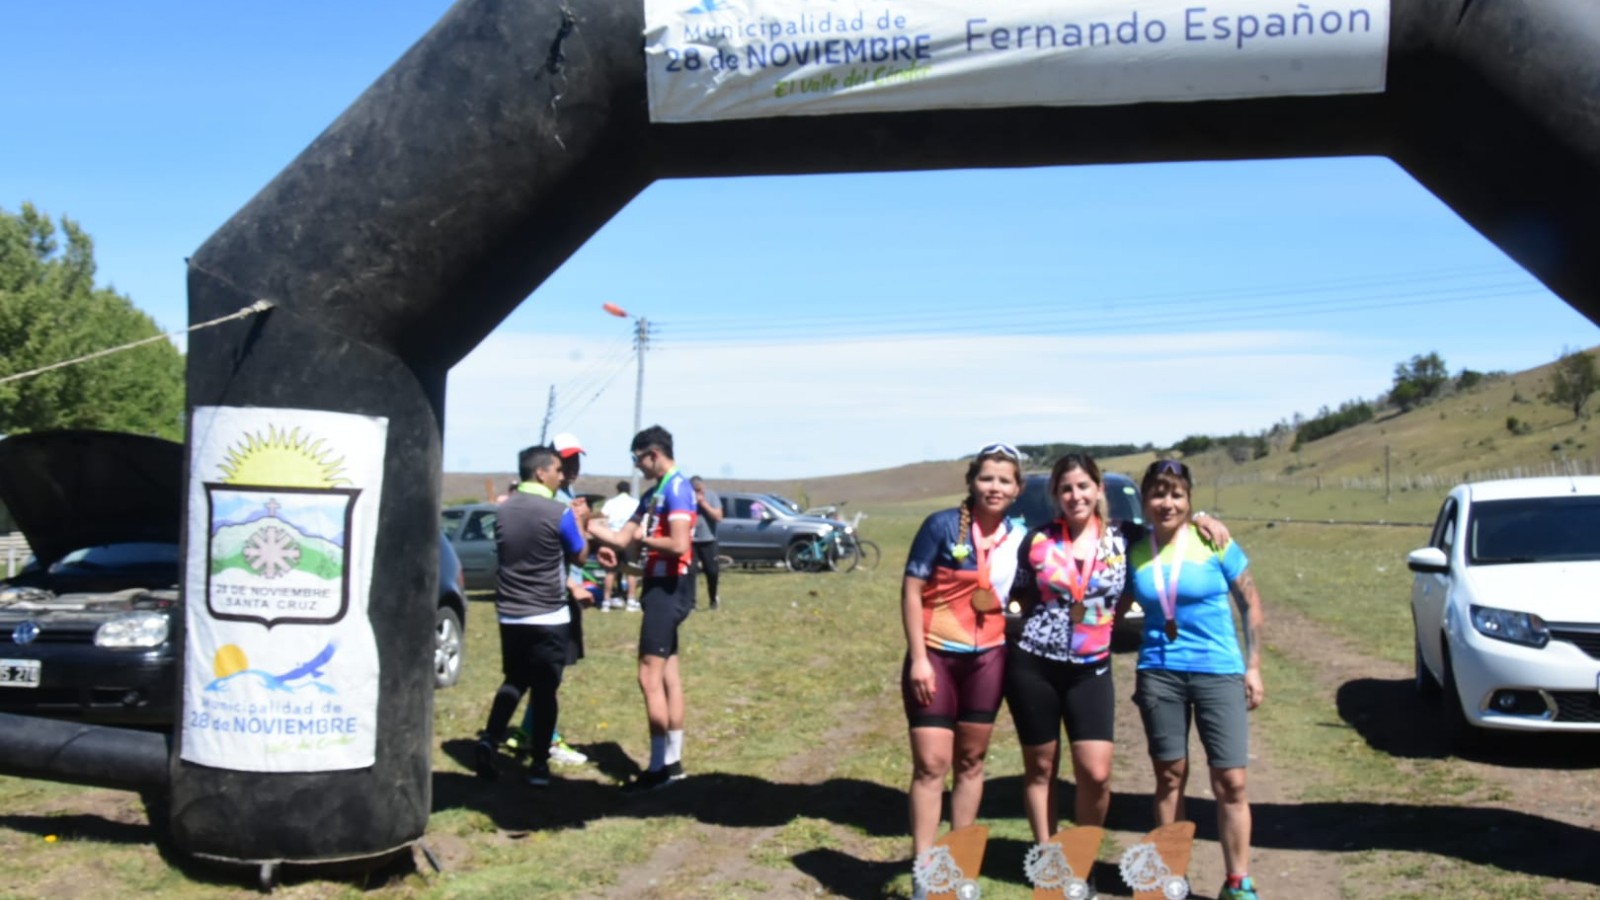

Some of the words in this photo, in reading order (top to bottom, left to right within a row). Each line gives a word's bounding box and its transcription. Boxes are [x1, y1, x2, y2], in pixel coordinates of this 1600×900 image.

[683, 9, 864, 42] Municipalidad
[876, 8, 906, 30] de
[966, 11, 1167, 51] Fernando
[1184, 3, 1371, 49] Españon
[665, 46, 702, 73] 28
[709, 46, 740, 71] de
[746, 34, 932, 70] NOVIEMBRE
[801, 72, 838, 94] Valle
[843, 67, 869, 88] del
[225, 597, 269, 609] SANTA
[276, 600, 318, 611] CRUZ
[230, 584, 246, 596] DE
[250, 586, 331, 598] NOVIEMBRE
[202, 698, 313, 716] Municipalidad
[322, 700, 343, 715] de
[190, 710, 210, 729] 28
[212, 716, 231, 732] de
[233, 715, 358, 736] NOVIEMBRE
